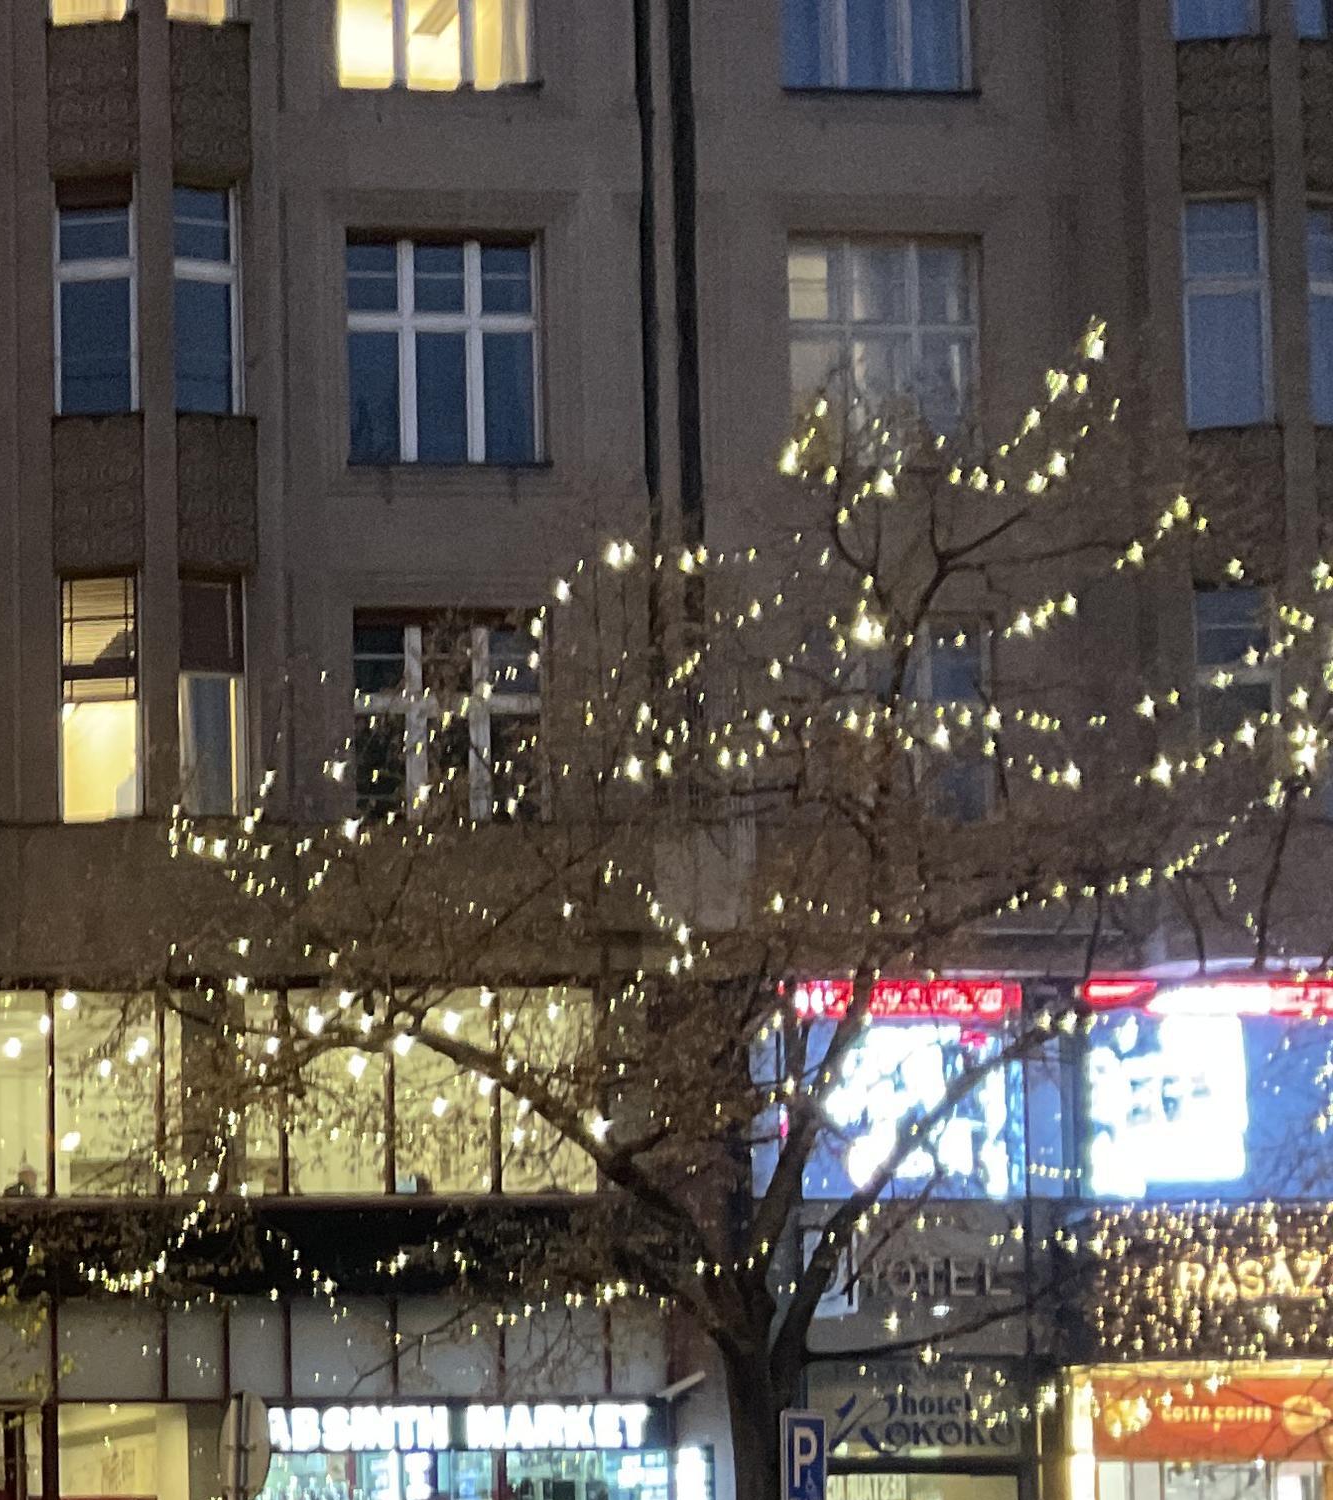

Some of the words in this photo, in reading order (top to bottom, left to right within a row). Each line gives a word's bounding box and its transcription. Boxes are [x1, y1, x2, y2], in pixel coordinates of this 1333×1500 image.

[269, 1405, 449, 1451] ABSINTH
[466, 1404, 647, 1450] MARKET
[793, 1426, 818, 1488] P
